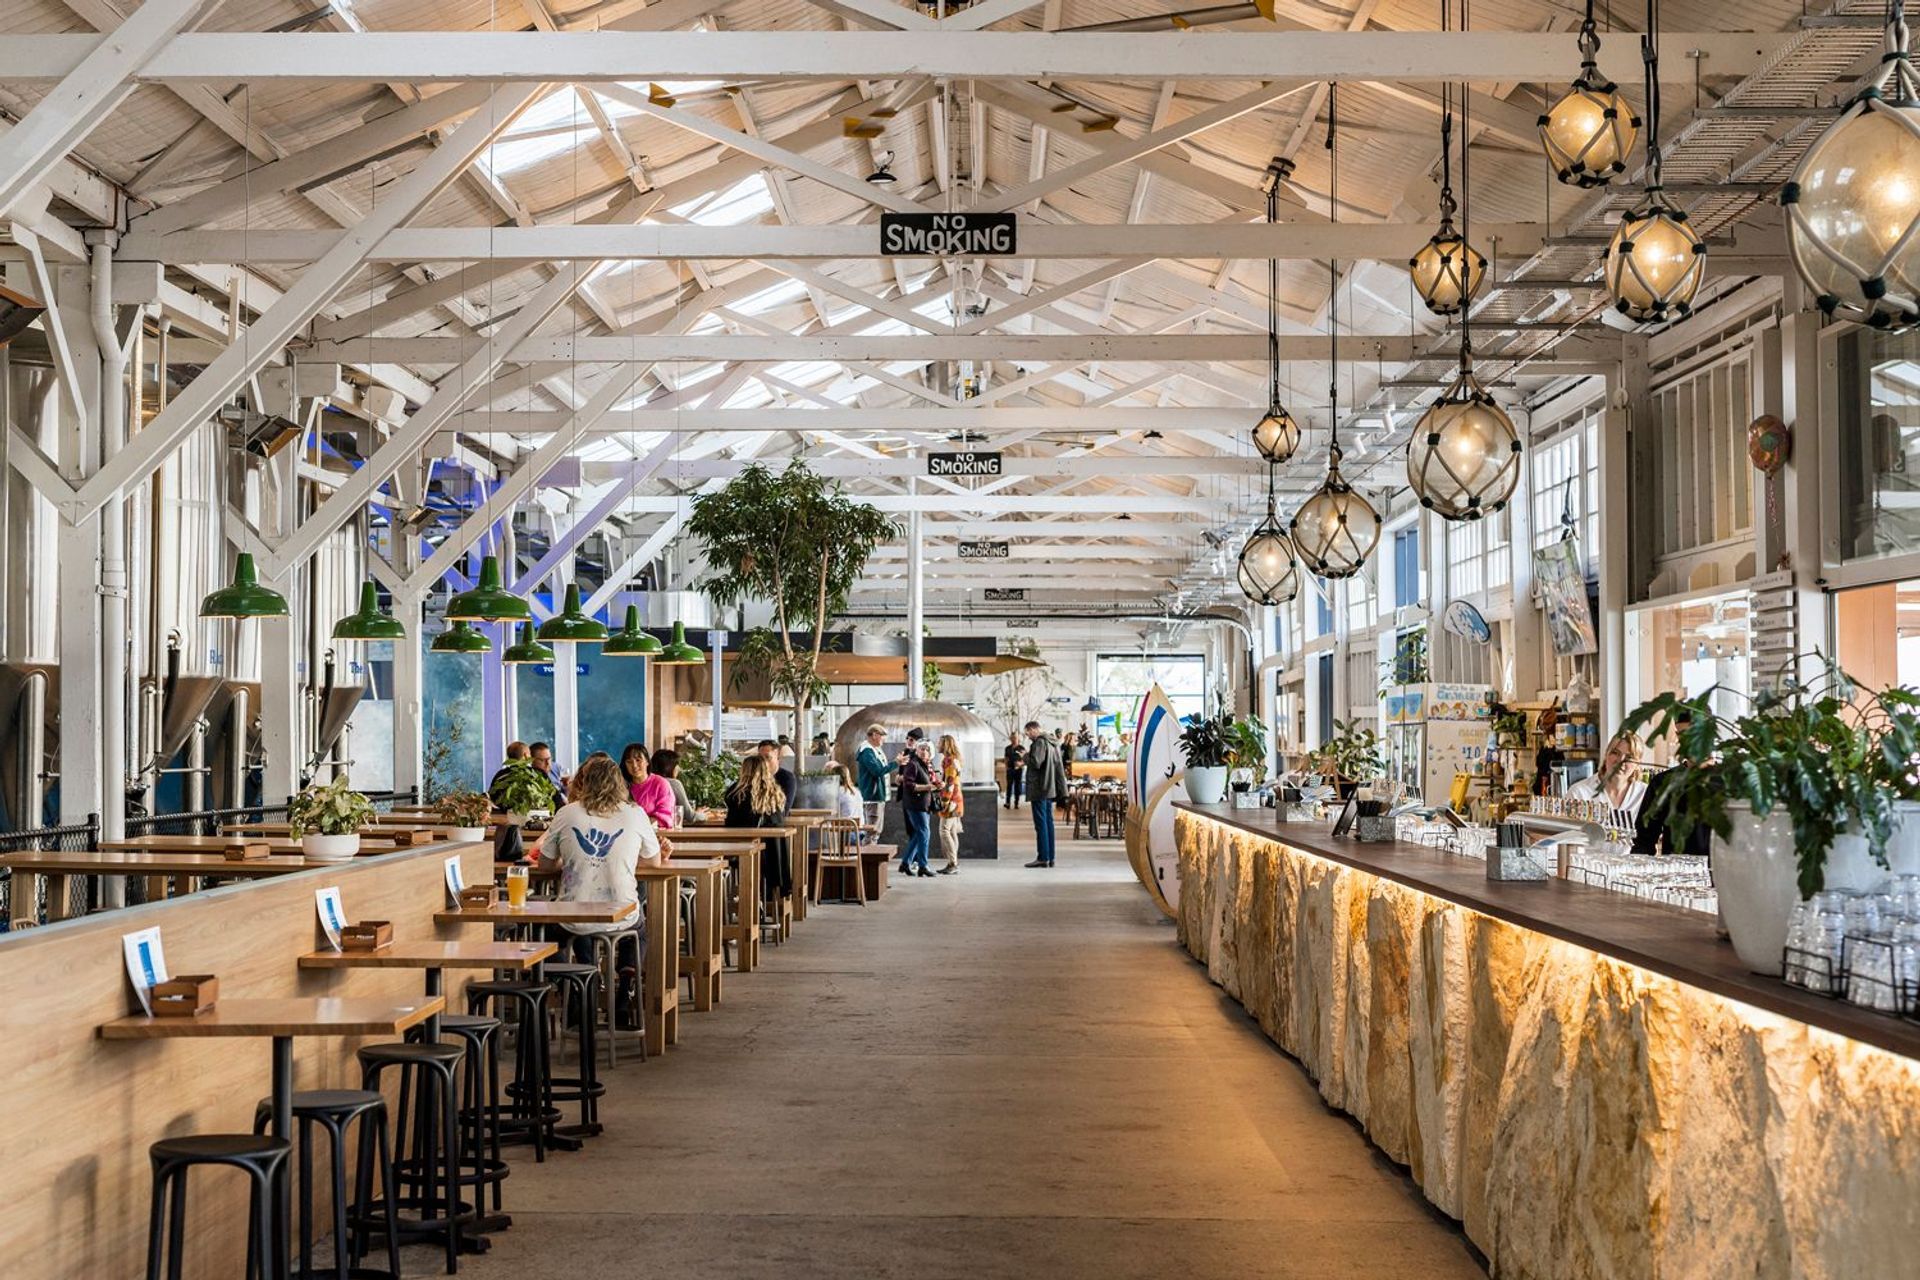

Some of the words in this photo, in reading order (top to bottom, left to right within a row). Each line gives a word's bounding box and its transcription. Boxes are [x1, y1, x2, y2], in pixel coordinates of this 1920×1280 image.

[933, 215, 967, 230] NO
[886, 224, 1010, 251] SMOKING
[956, 453, 975, 462] NO
[931, 458, 999, 474] SMOKING
[960, 545, 1007, 557] SMOKING
